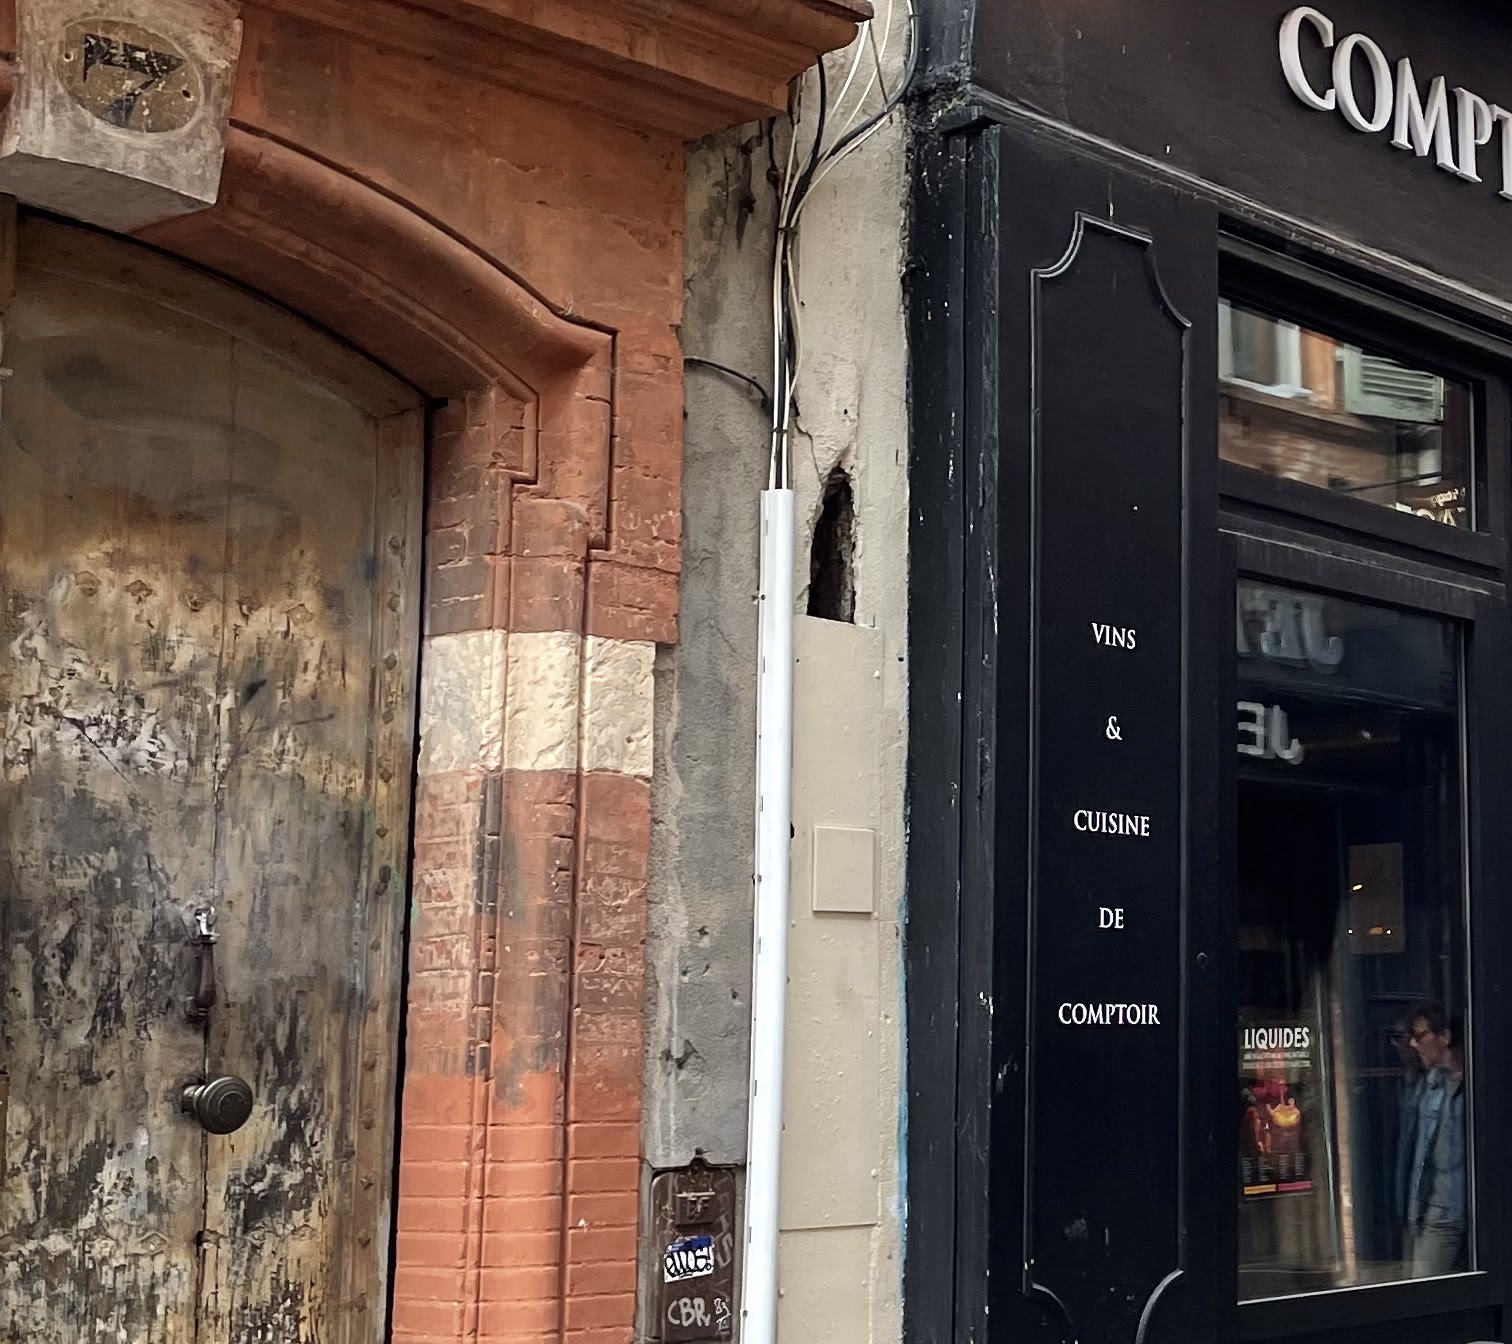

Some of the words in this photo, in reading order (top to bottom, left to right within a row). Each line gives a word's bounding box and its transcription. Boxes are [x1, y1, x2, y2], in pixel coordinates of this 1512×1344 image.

[1092, 623, 1136, 649] VINS
[1106, 716, 1123, 740] &
[1074, 810, 1149, 836] CUISINE
[1099, 907, 1124, 929] DE
[1058, 1003, 1160, 1026] COMPTOIR
[1244, 1027, 1310, 1050] LIQUIDES
